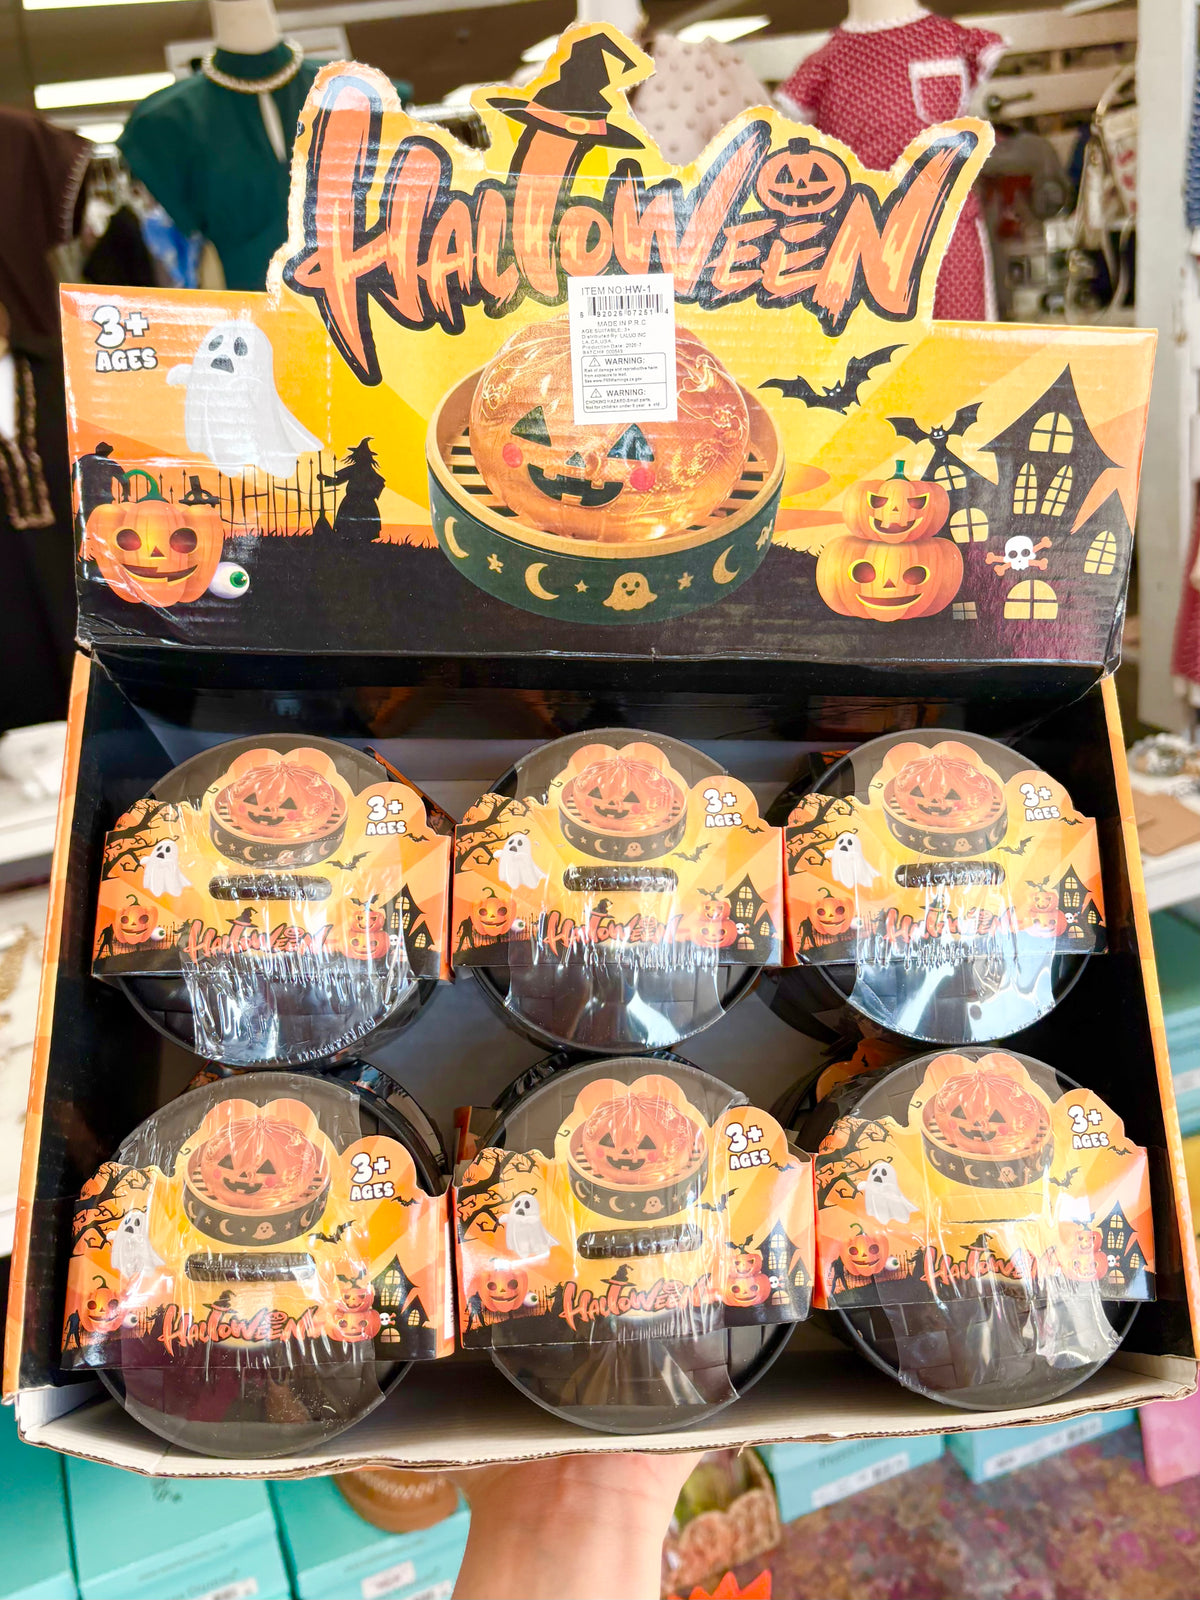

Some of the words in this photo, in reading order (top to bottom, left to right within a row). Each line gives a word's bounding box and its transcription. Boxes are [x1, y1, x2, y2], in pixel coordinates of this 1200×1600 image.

[581, 286, 605, 296] ITEM
[92, 305, 150, 349] 3+
[95, 347, 158, 373] AGES
[606, 389, 646, 397] WARNING:
[703, 788, 737, 814] 3+
[1020, 783, 1052, 808] 3+
[367, 795, 404, 821] 3+
[1025, 805, 1060, 822] AGES
[366, 820, 407, 836] AGES
[705, 812, 743, 828] AGES
[1068, 1104, 1103, 1134] 3+
[725, 1122, 764, 1153] 3+
[1072, 1132, 1110, 1150] AGES
[351, 1152, 391, 1184] 3+
[729, 1148, 771, 1170] AGES
[350, 1181, 395, 1201] AGES
